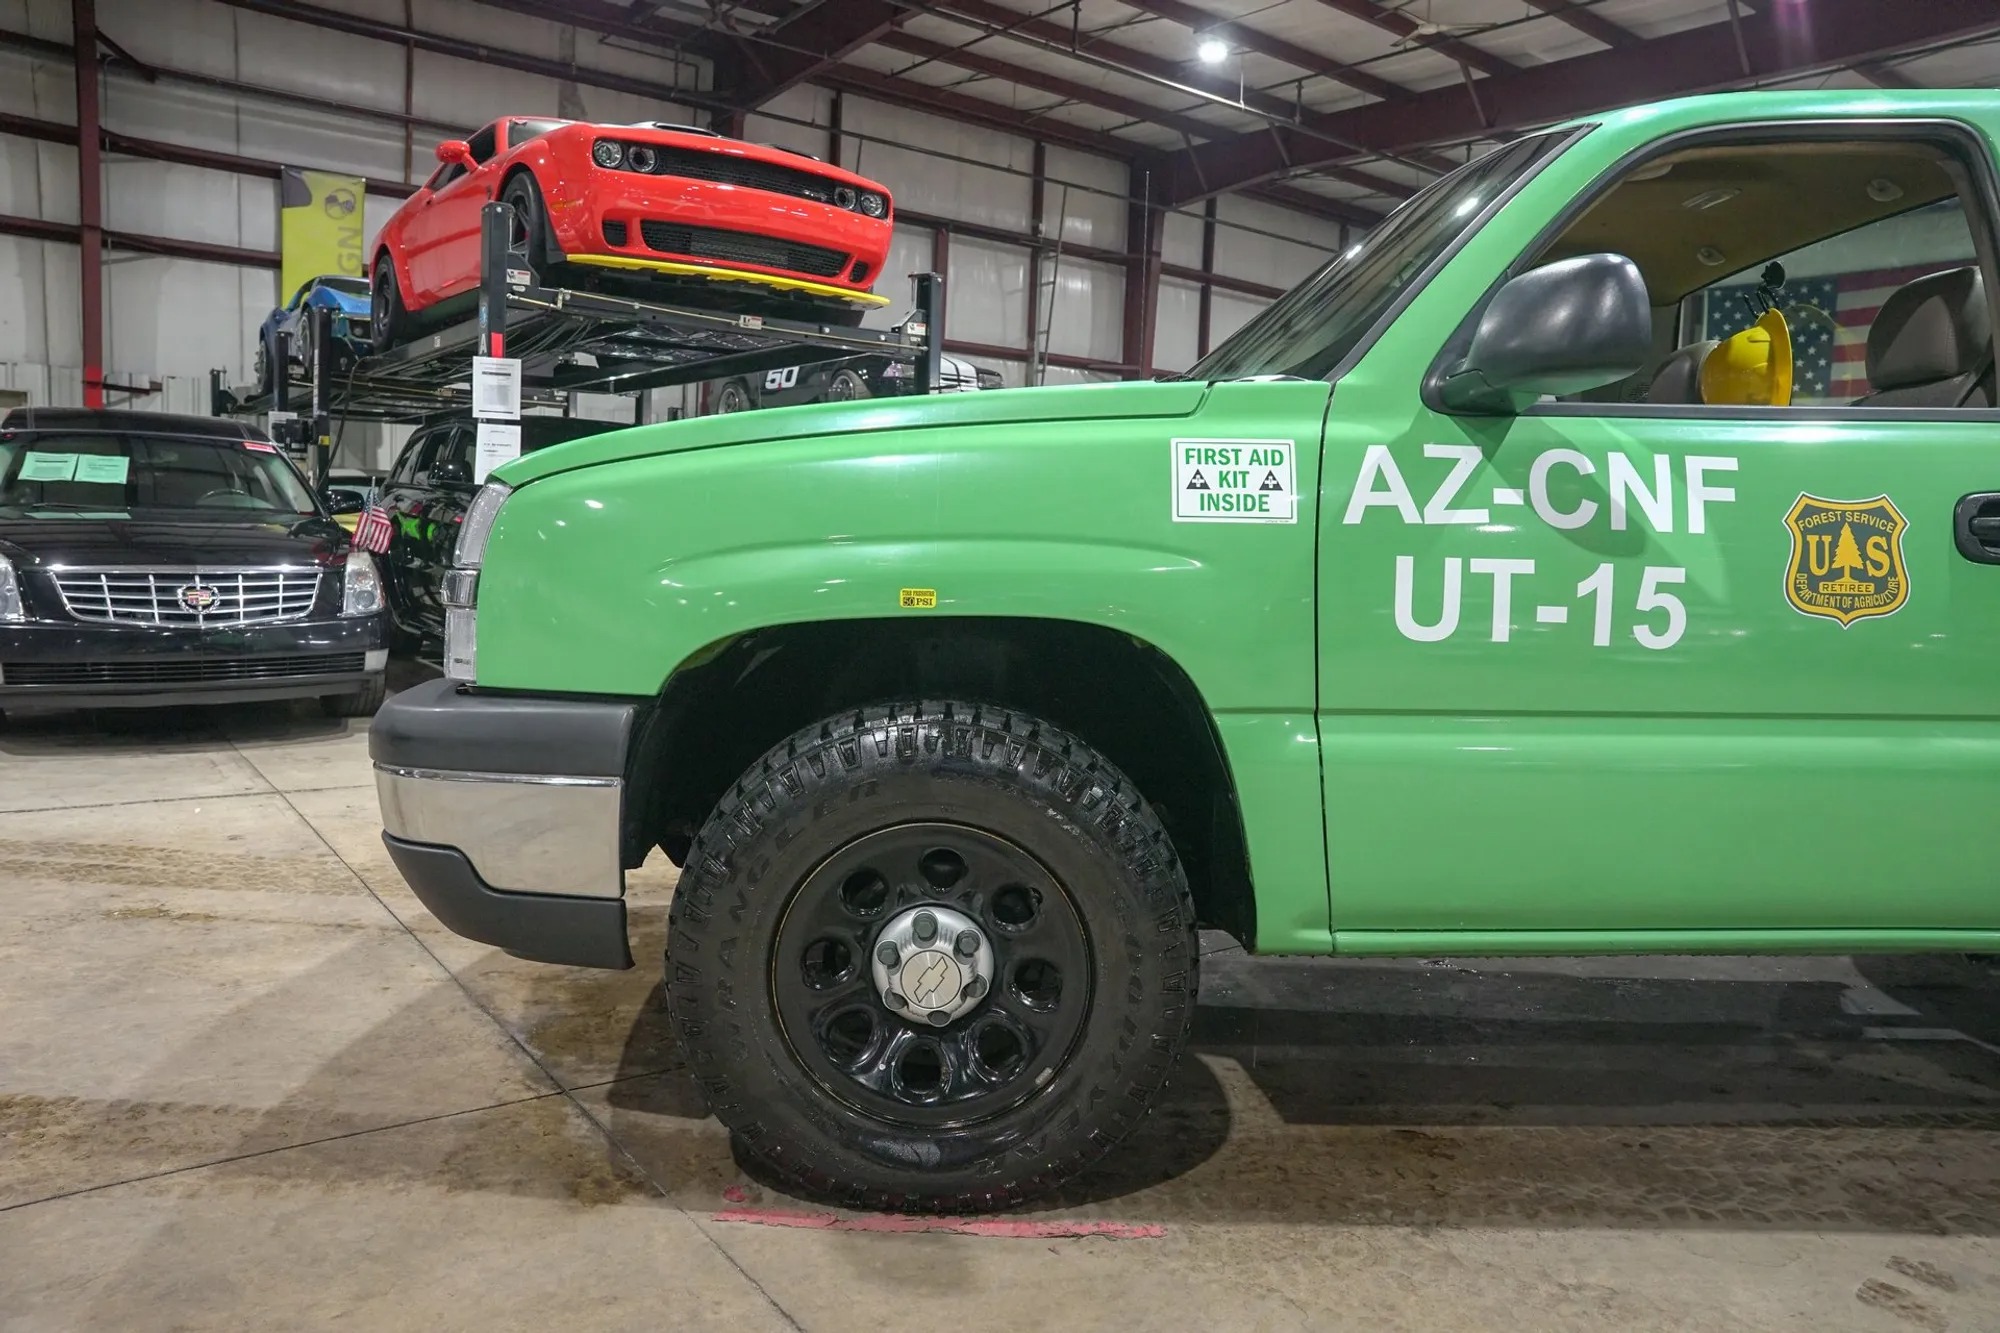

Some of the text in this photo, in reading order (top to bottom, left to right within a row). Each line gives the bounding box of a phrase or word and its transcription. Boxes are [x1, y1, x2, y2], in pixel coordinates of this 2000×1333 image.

[765, 366, 800, 389] 50
[1185, 448, 1284, 466] FIRST AID
[1219, 470, 1250, 488] KIT
[1342, 443, 1739, 534] AZ-CNF
[1199, 493, 1270, 512] INSIDE
[1797, 511, 1895, 533] FOREST SERVICE
[1796, 573, 1899, 609] DEPARTMENT OF AGRICULTURE
[1822, 583, 1872, 593] RETIREE
[916, 597, 933, 606] PSI
[1394, 555, 1687, 650] UT-15
